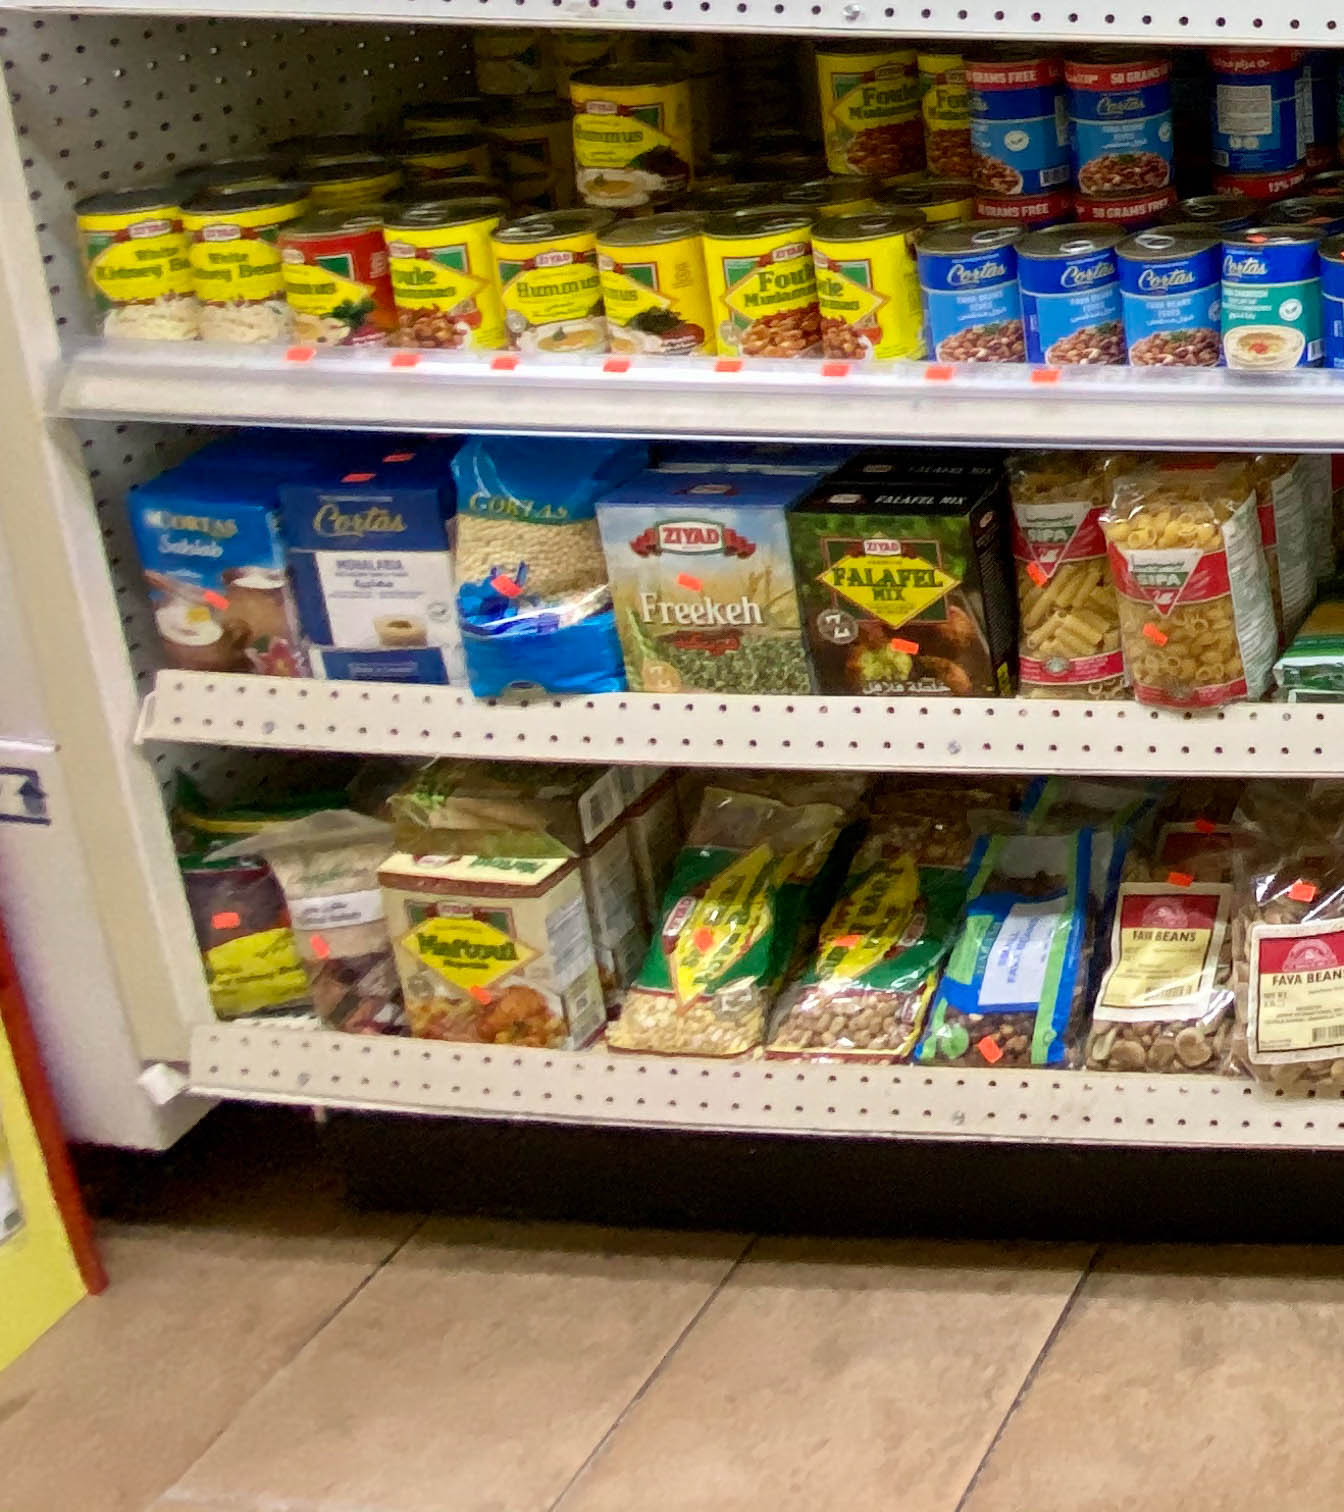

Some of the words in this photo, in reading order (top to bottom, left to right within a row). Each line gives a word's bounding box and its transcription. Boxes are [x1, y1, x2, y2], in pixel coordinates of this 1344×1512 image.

[1006, 70, 1038, 84] FREE
[945, 262, 1007, 286] Cortas
[1060, 262, 1117, 287] Cortas
[1137, 269, 1197, 291] Cortas
[874, 494, 935, 506] FALAFEL
[939, 494, 968, 506] MIX
[312, 503, 408, 538] Cortas
[662, 525, 721, 547] ZIYAD
[865, 540, 900, 555] ZIYAD
[831, 565, 944, 589] FALAFEL
[872, 586, 907, 603] MIX
[639, 591, 765, 626] Freekeh
[1156, 930, 1197, 943] BEANS
[1271, 972, 1305, 986] FAVA
